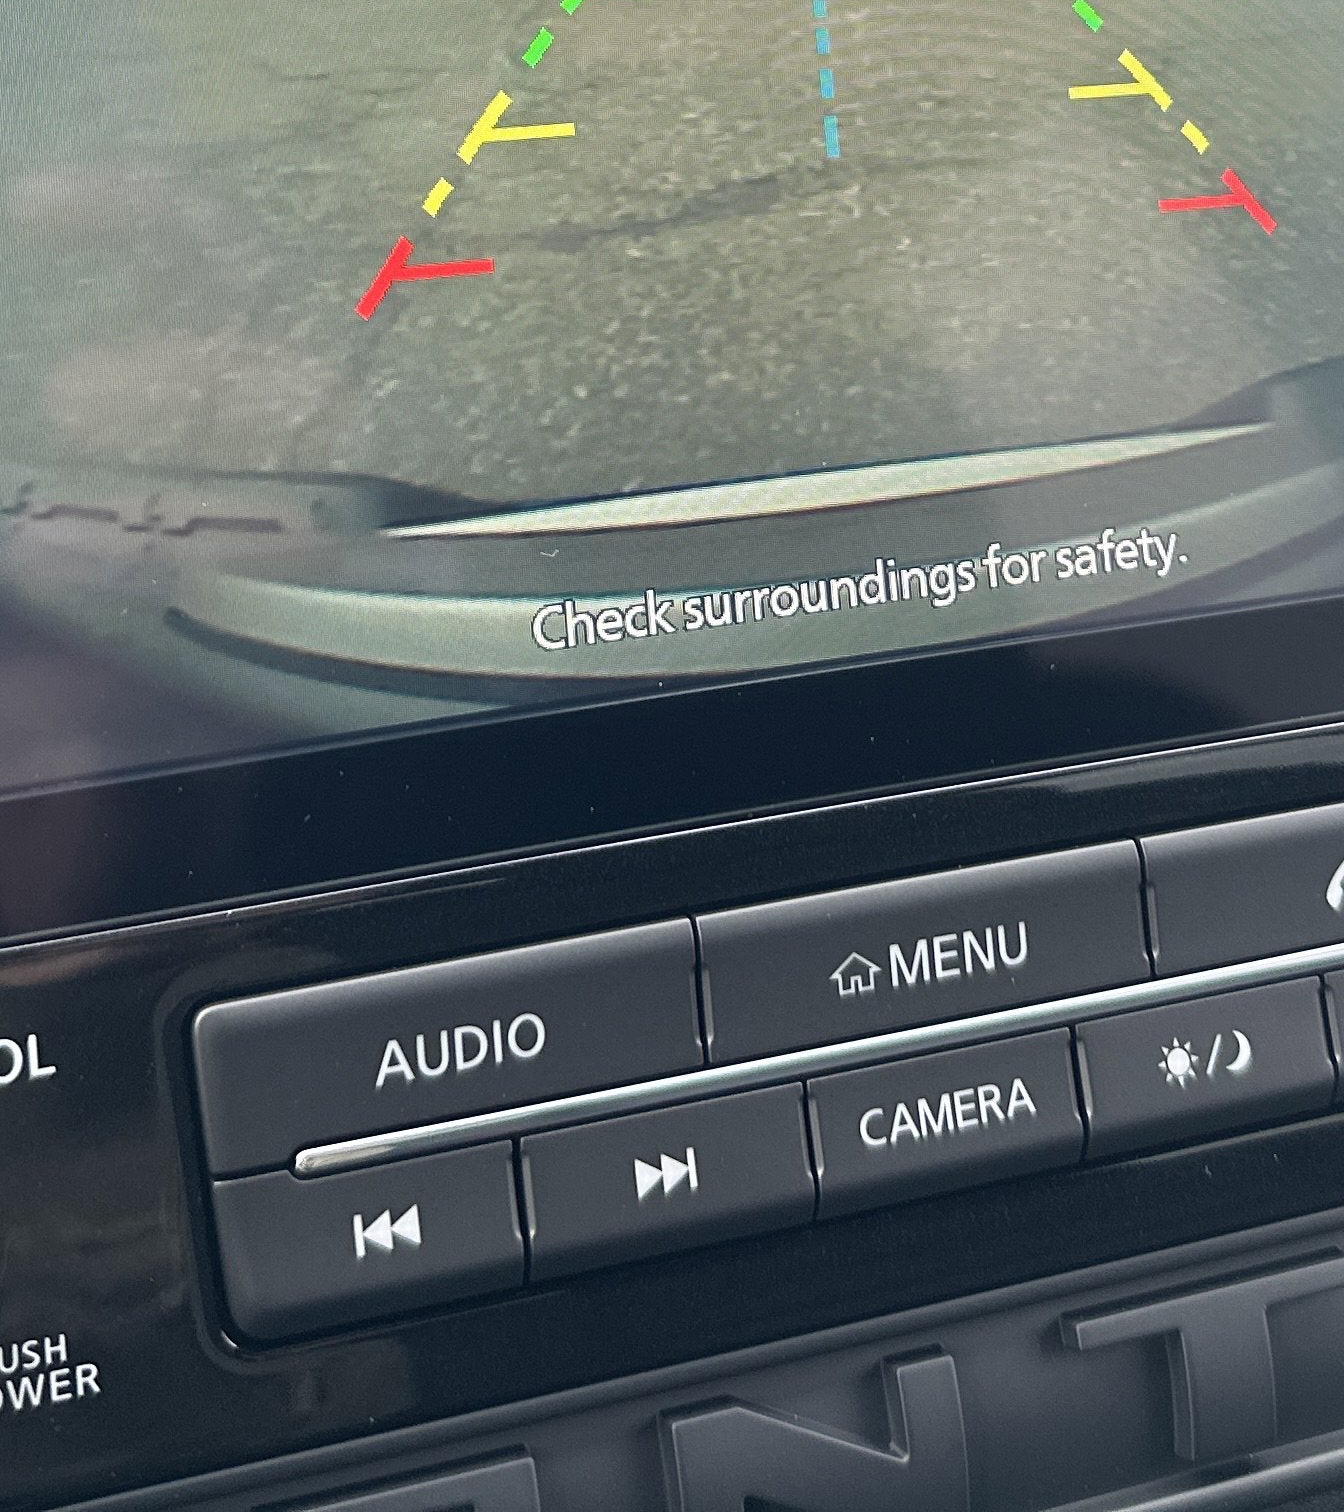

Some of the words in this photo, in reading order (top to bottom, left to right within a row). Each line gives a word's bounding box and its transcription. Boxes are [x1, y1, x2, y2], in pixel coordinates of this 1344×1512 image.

[531, 589, 675, 651] Check
[682, 558, 976, 632] surroundings
[980, 542, 1047, 589] for
[1055, 528, 1189, 578] safety.
[887, 921, 1030, 988] MENU
[375, 1012, 546, 1088] AUDIO
[859, 1077, 1037, 1147] CAMERA
